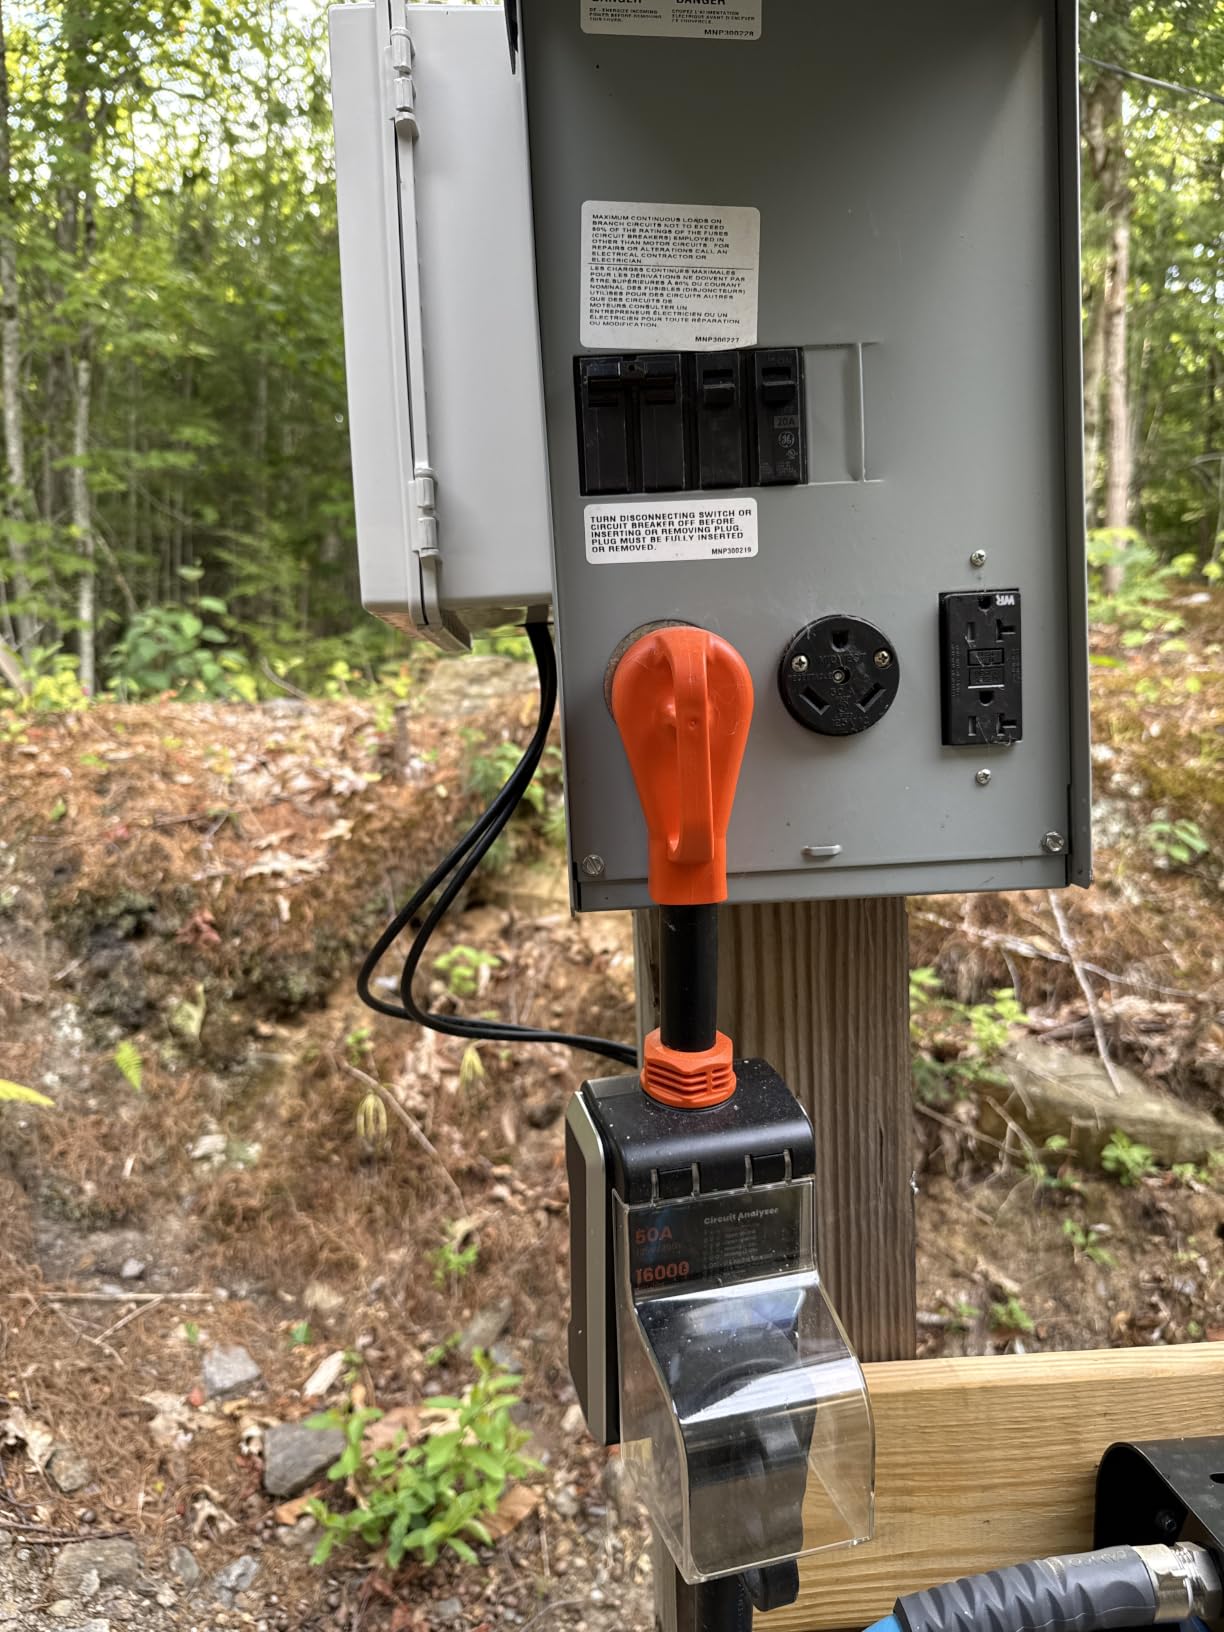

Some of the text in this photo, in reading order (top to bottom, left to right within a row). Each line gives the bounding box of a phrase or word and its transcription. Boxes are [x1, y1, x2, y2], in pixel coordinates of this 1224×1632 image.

[620, 512, 695, 522] DISCONNECTING
[699, 510, 734, 518] SWITCH
[632, 520, 674, 529] BREAKER
[591, 530, 641, 538] INSERTING
[662, 526, 710, 535] REMOVING
[698, 532, 744, 541] INSERTED
[609, 544, 656, 552] REMOVED.
[996, 594, 1015, 606] WR
[704, 1214, 736, 1225] Circuit
